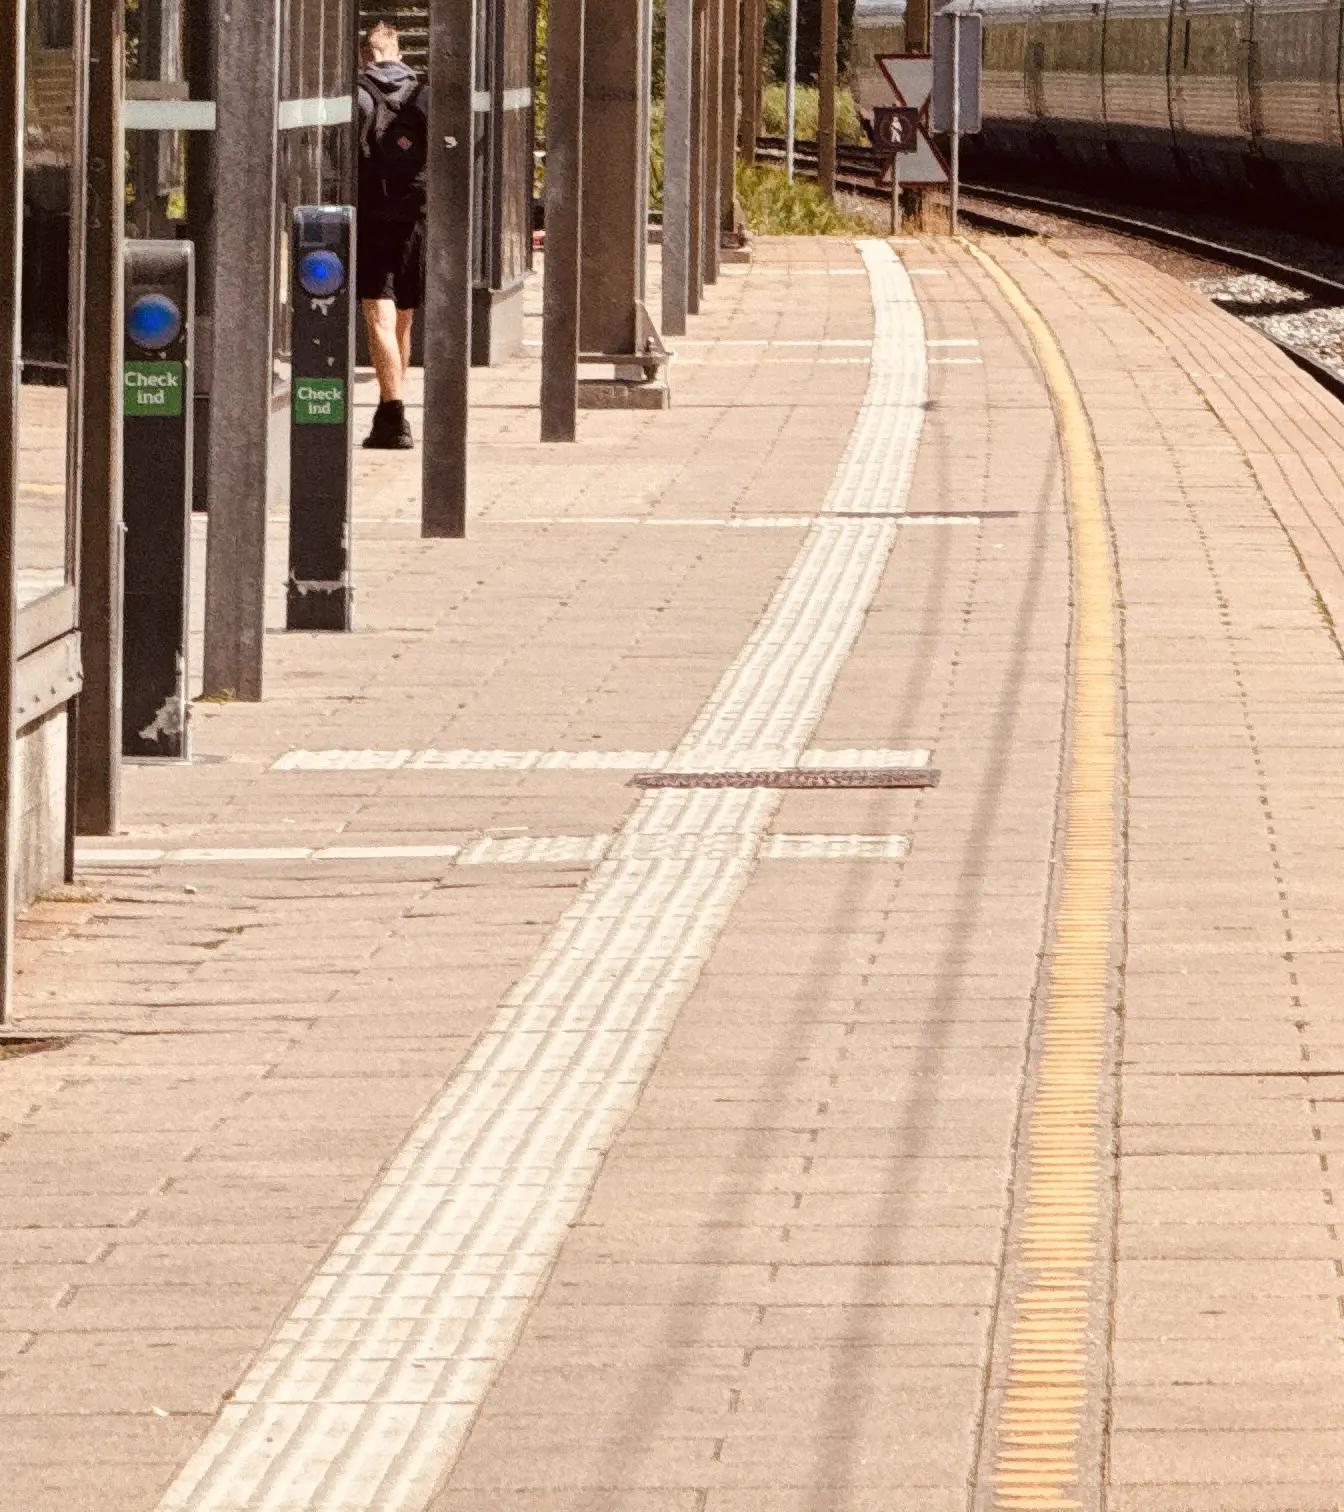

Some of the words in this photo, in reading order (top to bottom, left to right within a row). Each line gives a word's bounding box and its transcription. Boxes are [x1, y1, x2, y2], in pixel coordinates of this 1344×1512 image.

[124, 371, 178, 387] Check
[137, 390, 165, 404] ind
[297, 387, 342, 401] Check
[308, 402, 331, 415] ind
